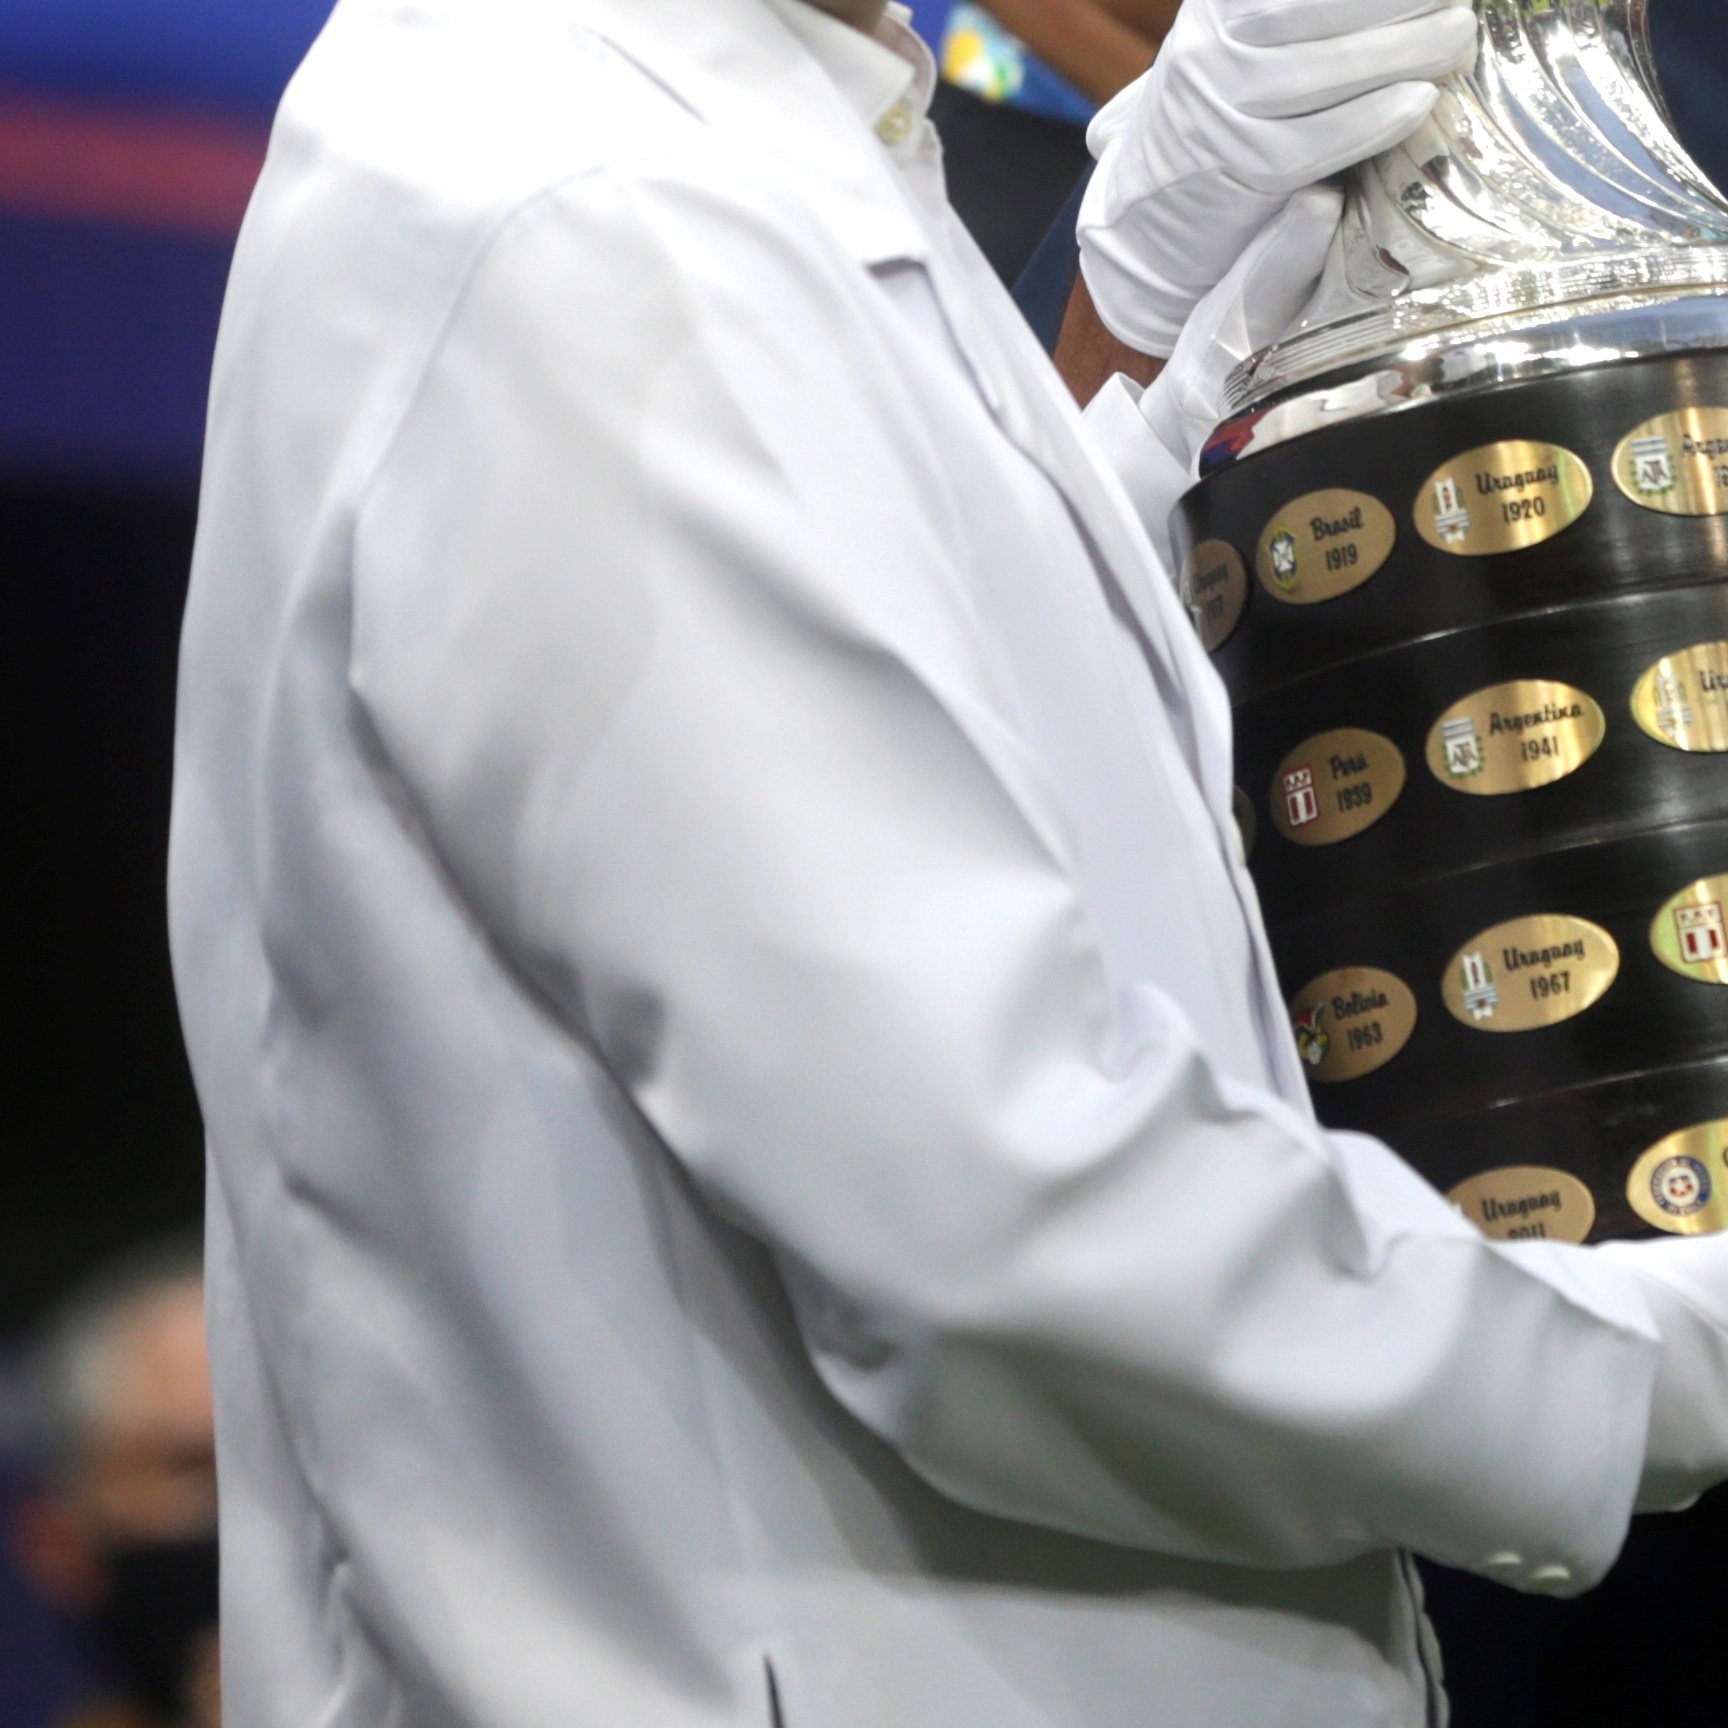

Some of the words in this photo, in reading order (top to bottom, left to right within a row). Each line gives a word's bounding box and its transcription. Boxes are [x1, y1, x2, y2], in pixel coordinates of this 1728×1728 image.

[1476, 464, 1559, 495] Uruguay
[1309, 505, 1364, 542] Brasil
[1501, 496, 1545, 524] 1920
[1325, 543, 1358, 572] 1919
[1489, 703, 1584, 736] Argentina
[1520, 736, 1559, 762] 1941
[1336, 782, 1373, 813] 1939
[1503, 940, 1585, 971] Uruguay
[1530, 971, 1571, 1001] 1967
[1332, 989, 1389, 1020] Bolivia
[1347, 1022, 1382, 1051] 1963
[1481, 1191, 1563, 1221] Uruguay
